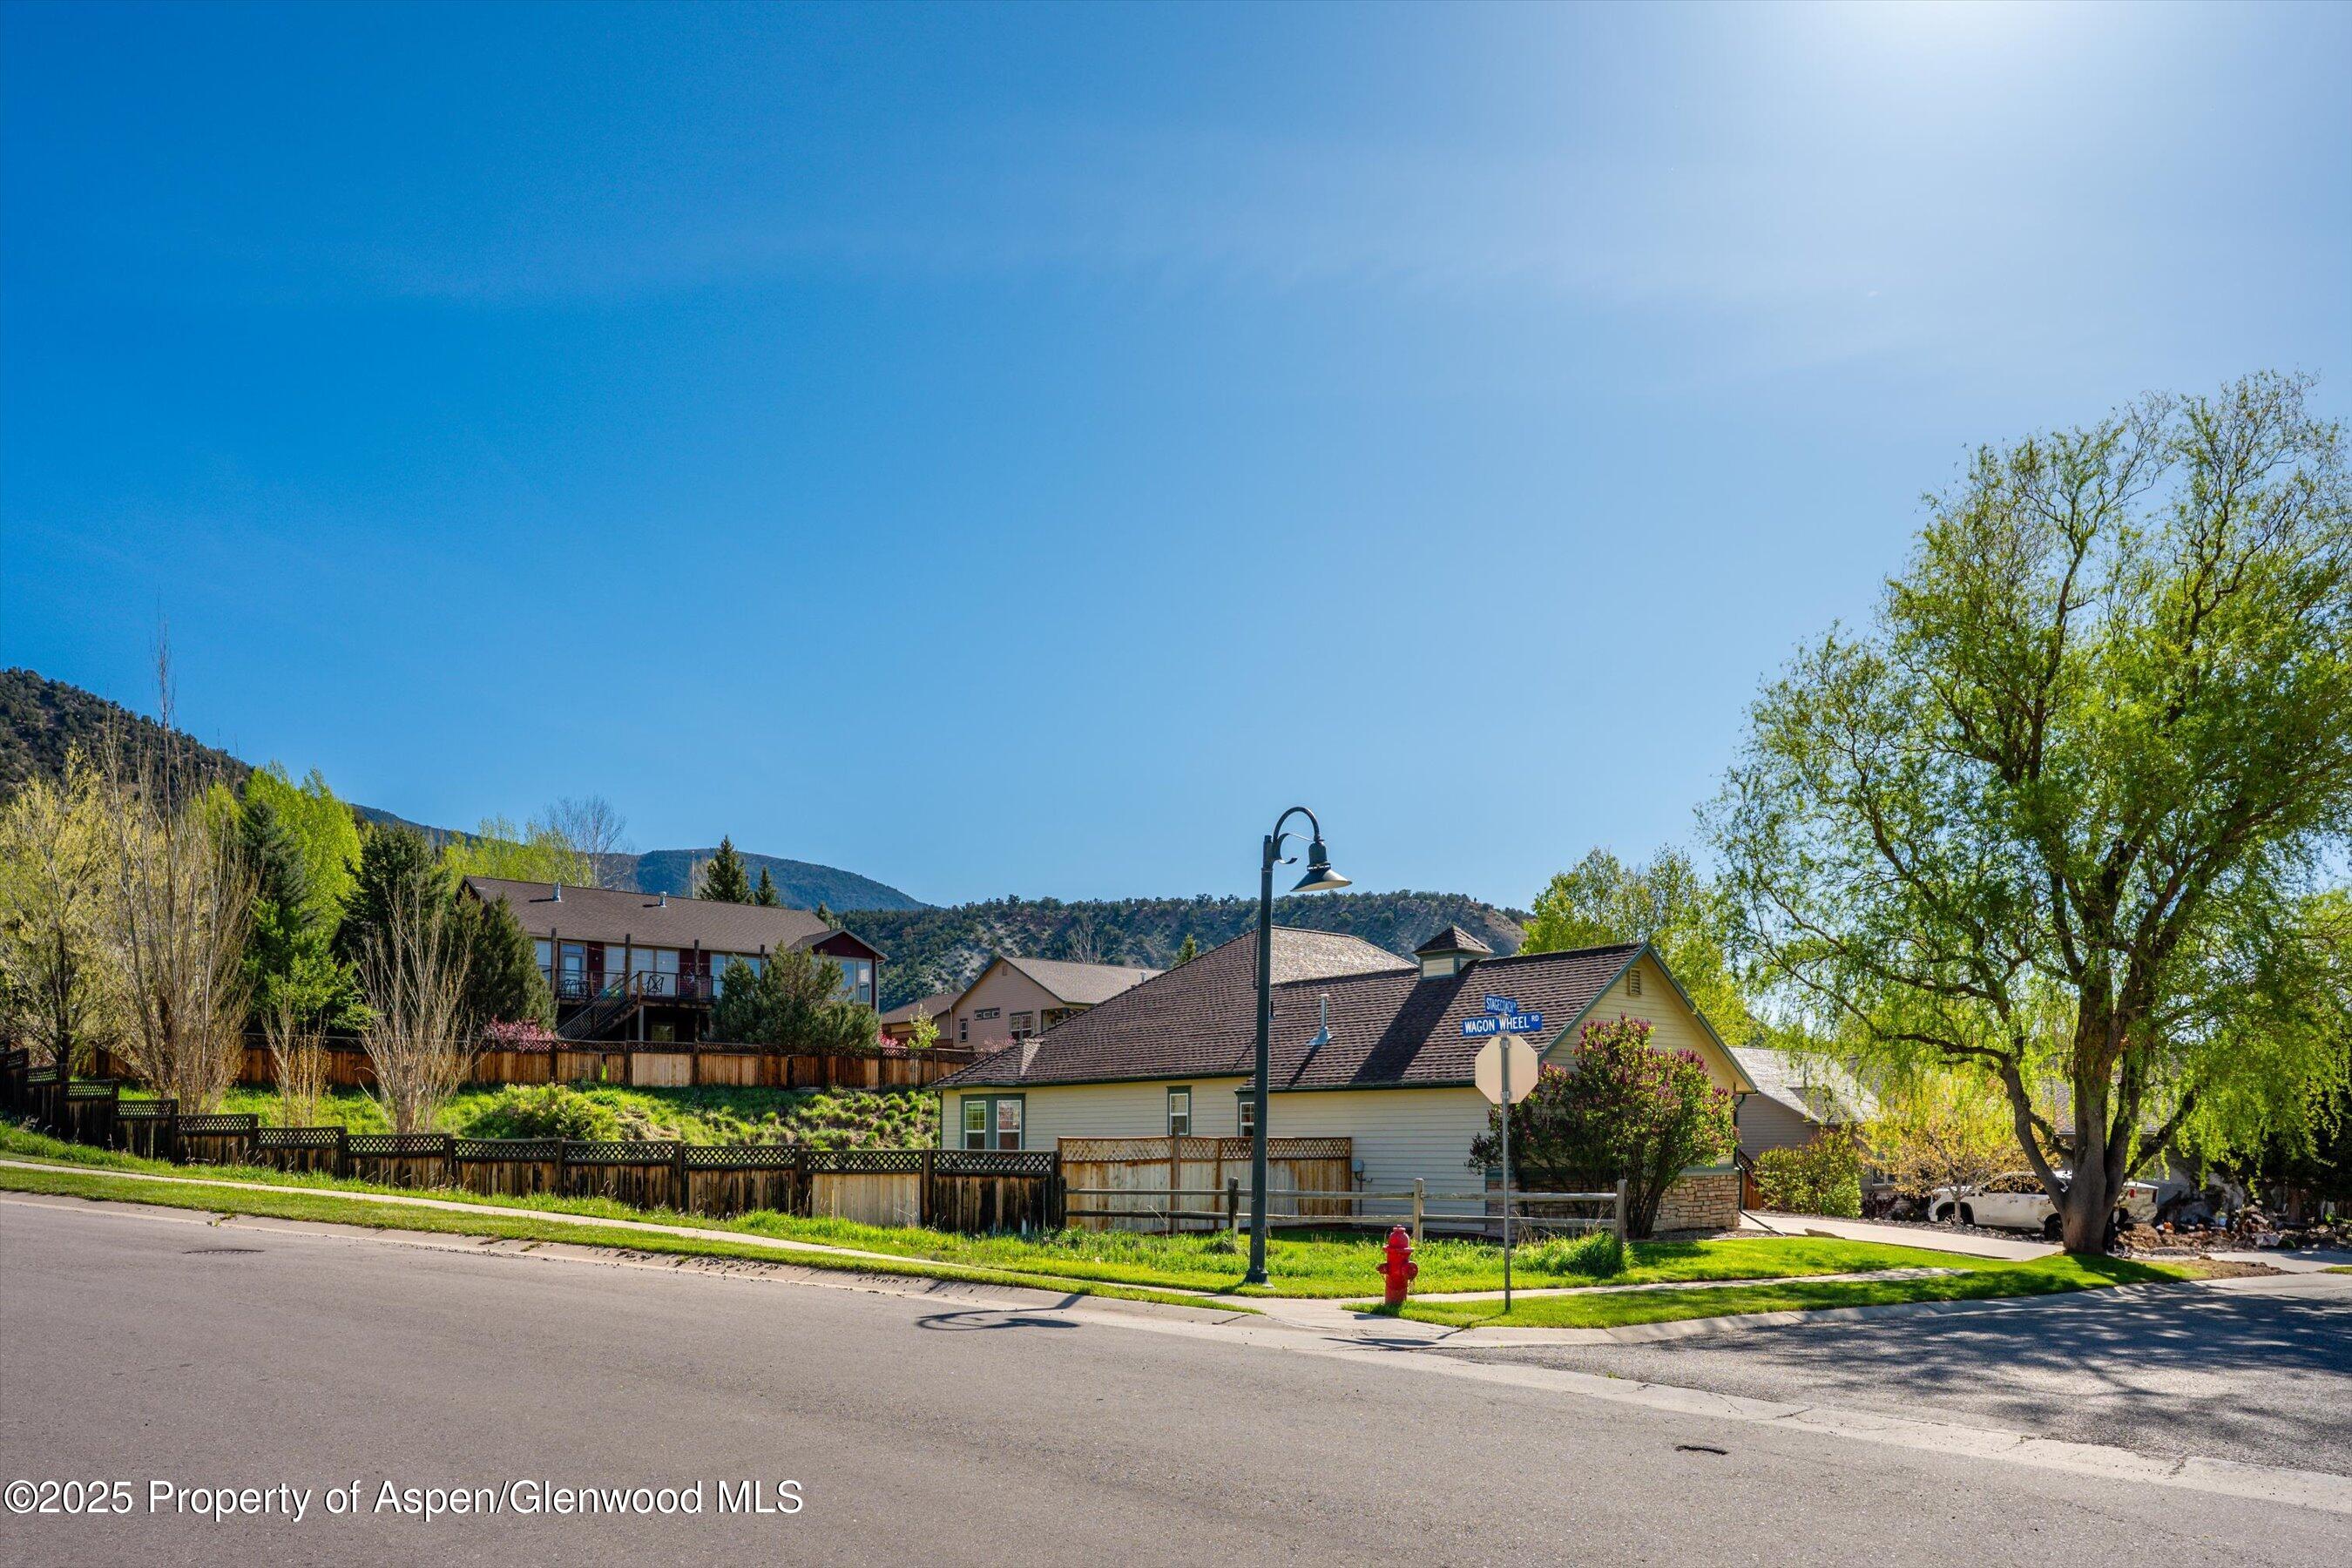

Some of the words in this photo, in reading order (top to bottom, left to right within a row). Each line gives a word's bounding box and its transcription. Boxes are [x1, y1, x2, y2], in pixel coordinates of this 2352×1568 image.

[1486, 997, 1513, 1013] STAGECOACH
[1464, 1019, 1495, 1033] WAGON
[1498, 1016, 1530, 1031] WHEEL
